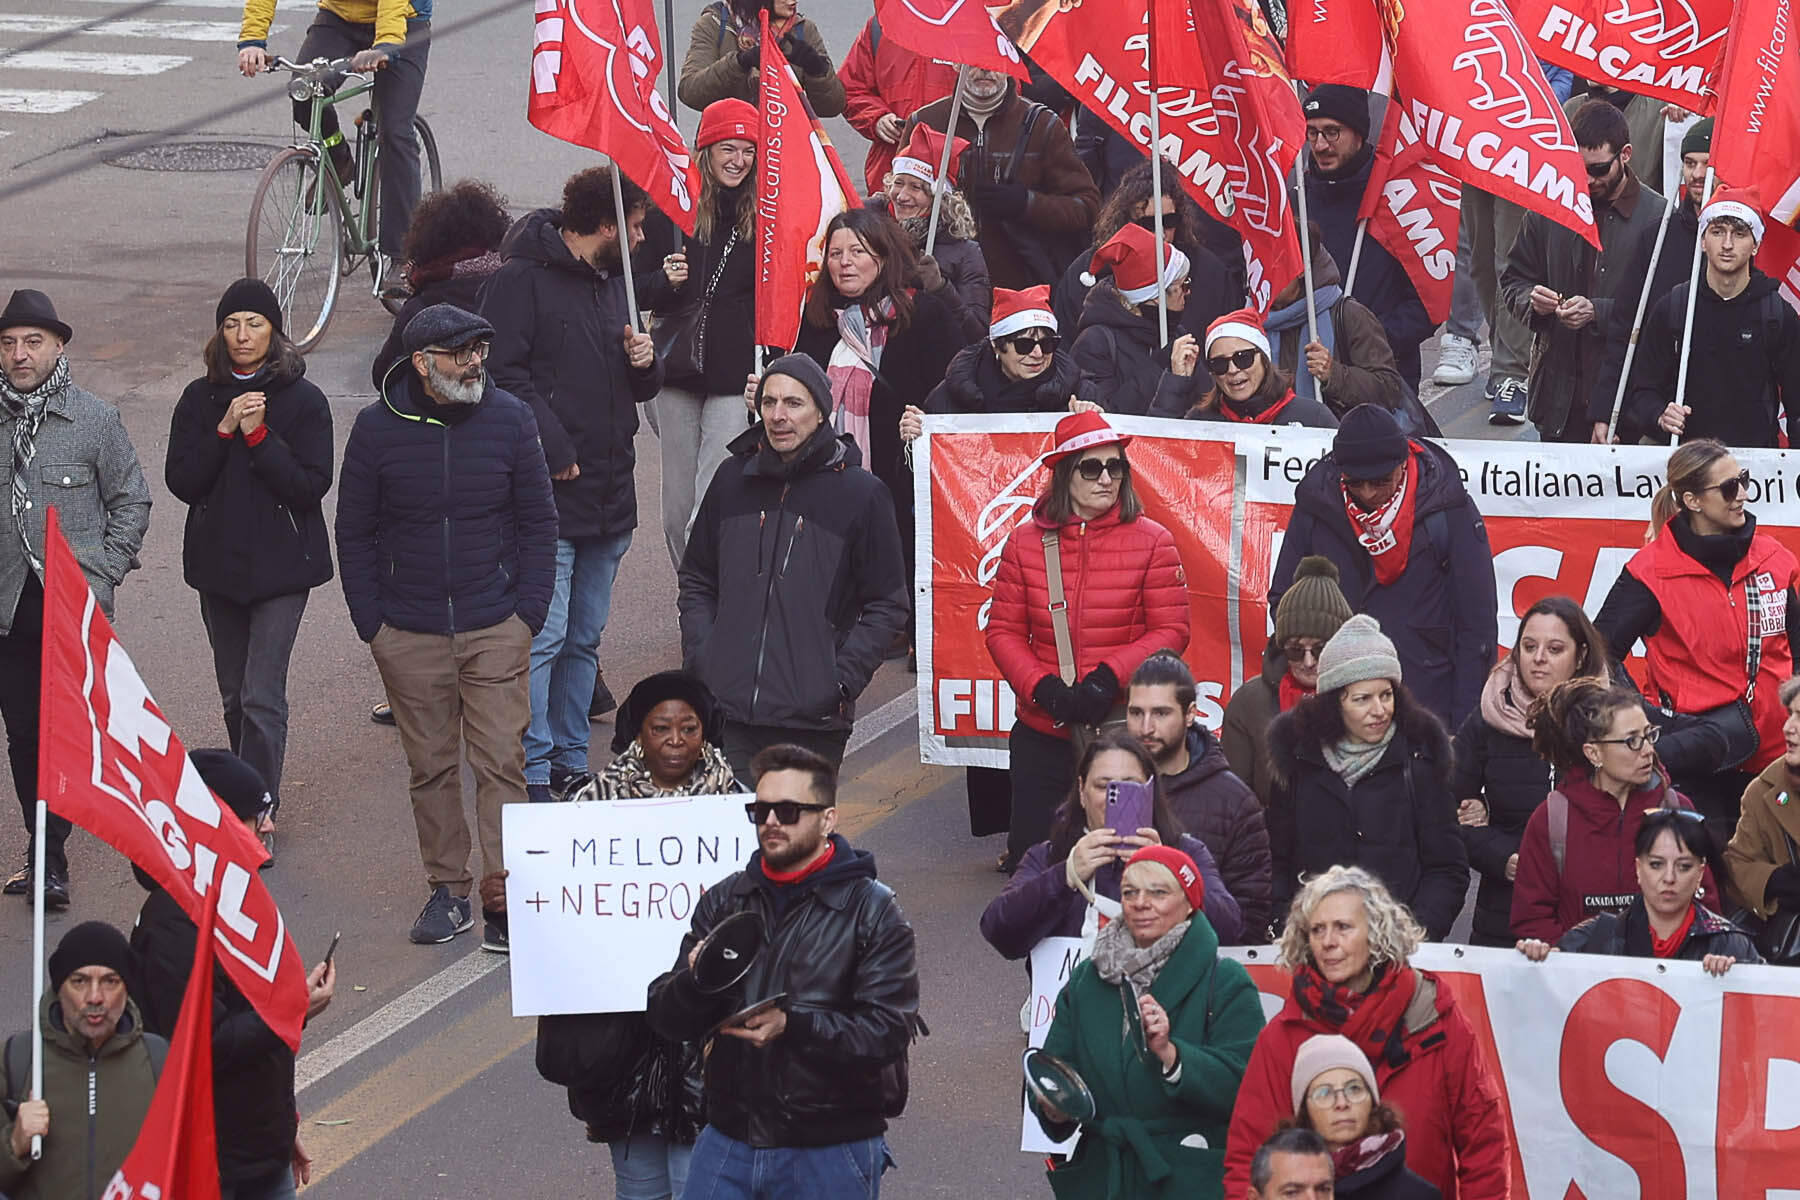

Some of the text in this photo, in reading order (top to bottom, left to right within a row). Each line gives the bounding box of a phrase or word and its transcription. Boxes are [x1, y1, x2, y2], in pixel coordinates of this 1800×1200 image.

[1537, 4, 1712, 97] FILCAM
[1074, 52, 1237, 219] FILCAMS
[1412, 98, 1594, 226] FILCAMS
[1479, 461, 1605, 500] Italiana
[571, 835, 741, 868] MELONI
